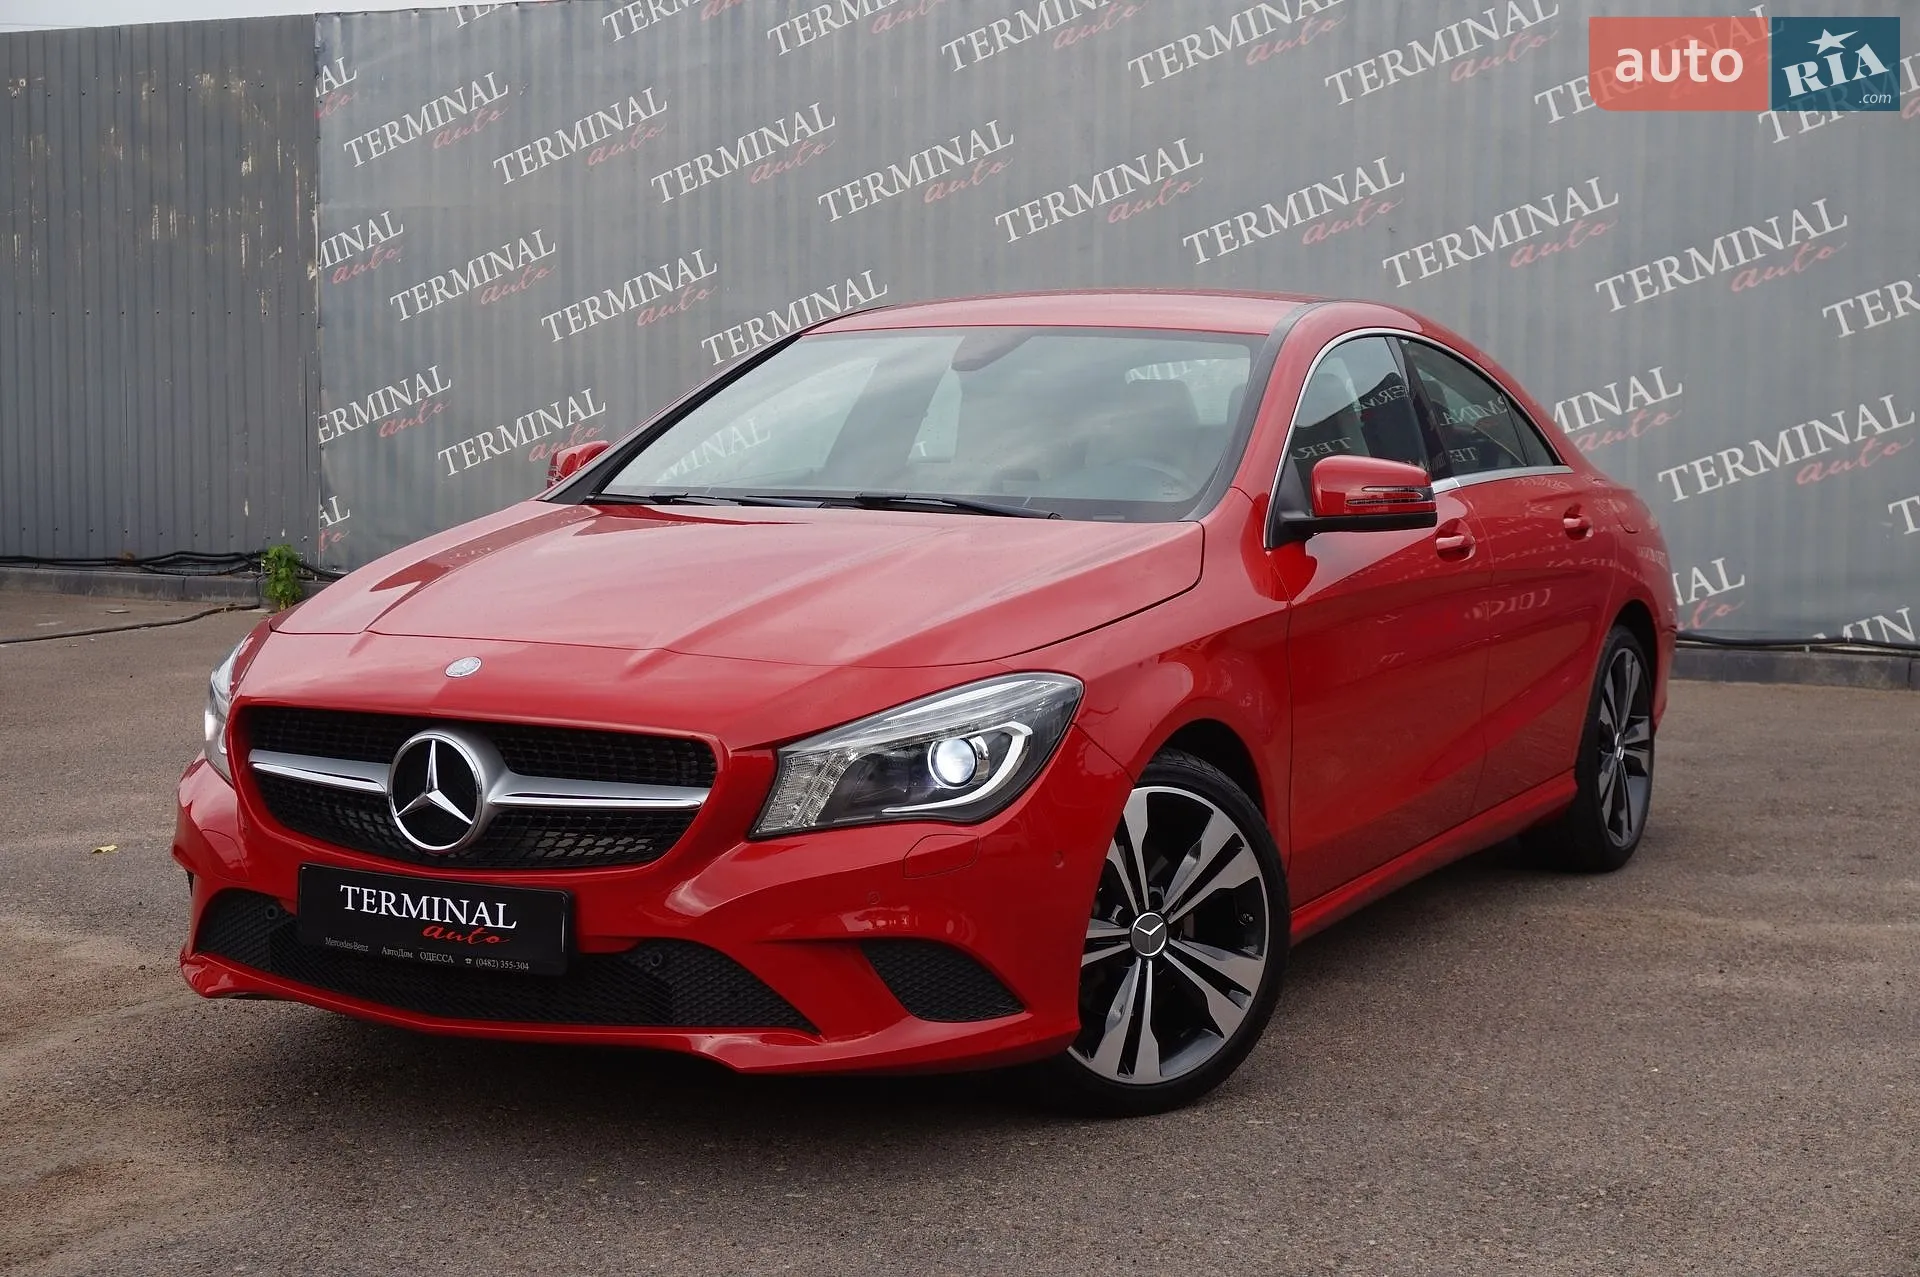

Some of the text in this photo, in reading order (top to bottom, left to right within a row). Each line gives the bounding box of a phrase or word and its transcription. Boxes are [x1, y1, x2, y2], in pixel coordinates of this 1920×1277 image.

[1053, 0, 1148, 49] auto
[1246, 14, 1347, 65] auto
[316, 57, 357, 98] AL
[1325, 0, 1558, 105] TERMINAL
[1450, 30, 1558, 81] auto
[344, 72, 508, 167] TERMINAL
[432, 106, 508, 149] auto
[493, 88, 667, 184] TERMINAL
[587, 121, 667, 167] auto
[651, 102, 836, 203] TERMINAL
[749, 139, 836, 186] auto
[818, 120, 1014, 222] TERMINAL
[923, 157, 1013, 204] auto
[995, 138, 1203, 243] TERMINAL
[1107, 177, 1203, 224] auto
[1183, 157, 1405, 264] TERMINAL
[1301, 198, 1404, 246] auto
[1382, 177, 1619, 287] TERMINAL
[331, 245, 403, 284] auto
[1509, 220, 1618, 269] auto
[1595, 198, 1848, 312] TERMINAL
[1729, 242, 1847, 293] auto
[390, 229, 555, 321] TERMINAL
[479, 264, 556, 305] auto
[541, 249, 717, 342] TERMINAL
[636, 286, 718, 328] auto
[700, 270, 887, 366] TERMINAL
[1822, 276, 1920, 338] TER
[378, 400, 450, 438] auto
[437, 388, 606, 476] TERMINAL
[1658, 394, 1915, 502] TERMINAL
[1796, 437, 1914, 485] auto
[340, 884, 517, 929] TERMINAL
[422, 923, 510, 945] auto
